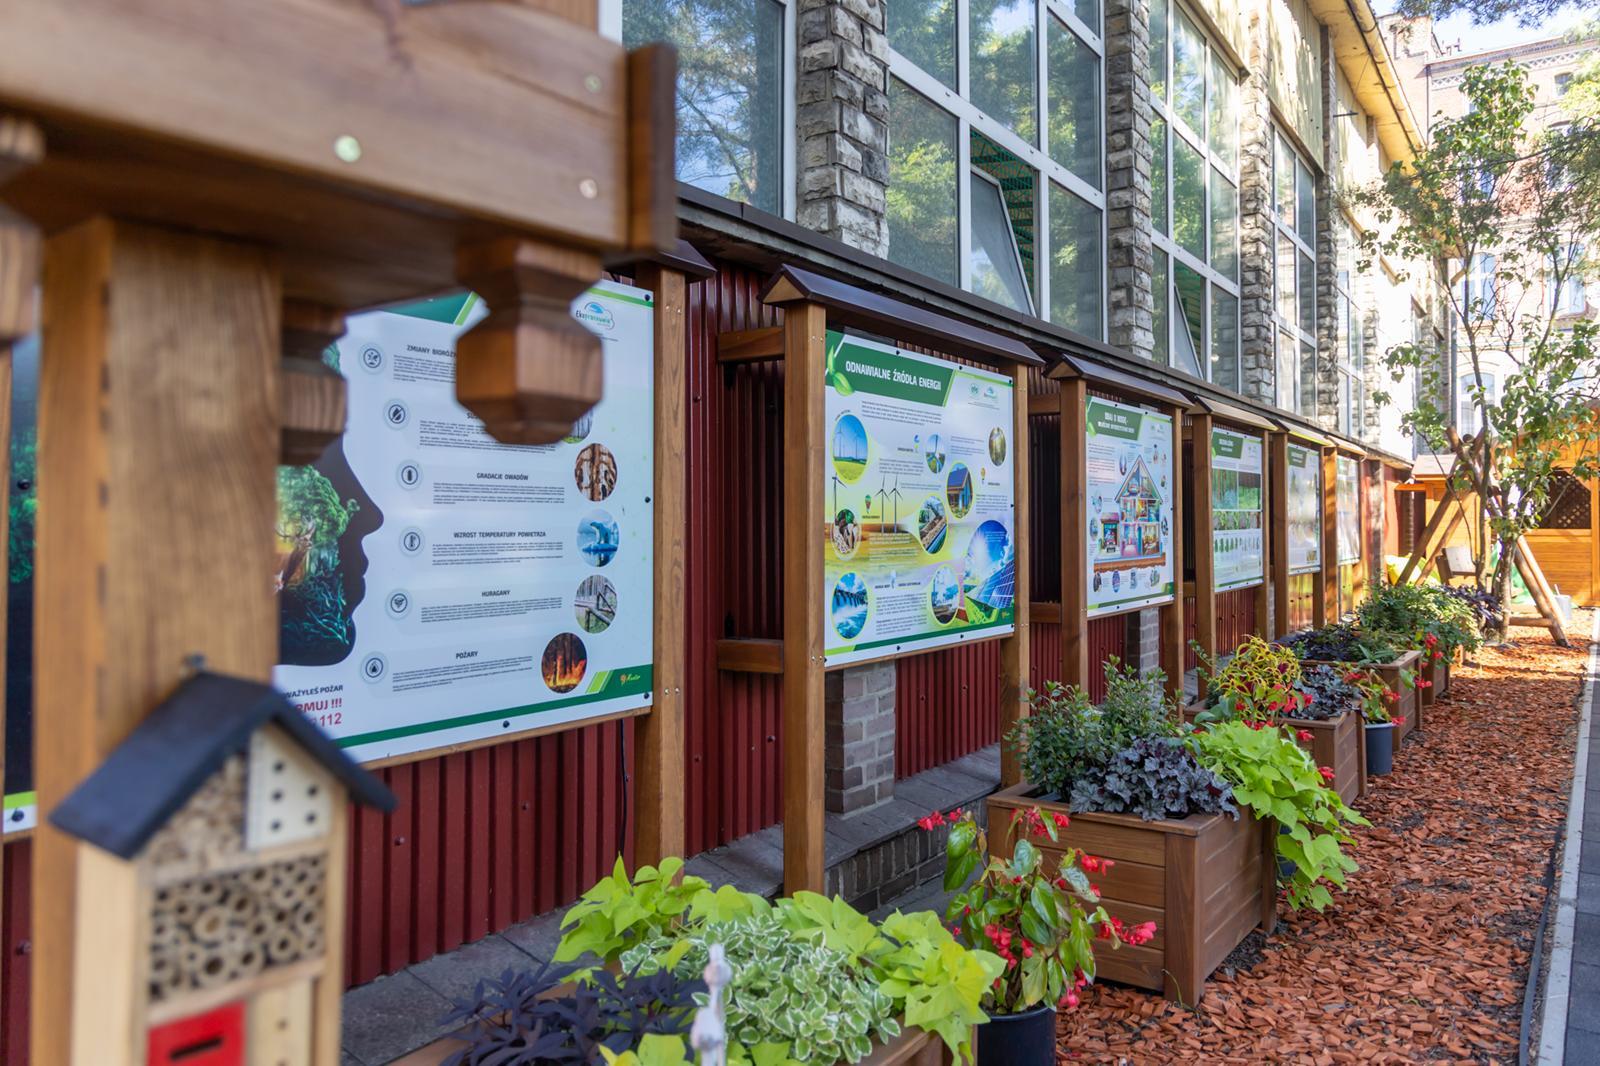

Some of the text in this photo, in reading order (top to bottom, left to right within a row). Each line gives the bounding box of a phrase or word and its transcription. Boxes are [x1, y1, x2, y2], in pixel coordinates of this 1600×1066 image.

[407, 344, 430, 354] ZMIANY
[845, 360, 942, 391] ODNAWIALNE ŹRÓDŁA ENERGII
[477, 472, 529, 481] GRADACJE OWADÓW
[456, 651, 479, 659] POŻARY
[320, 685, 343, 694] POŻAR
[320, 712, 342, 727] 112
